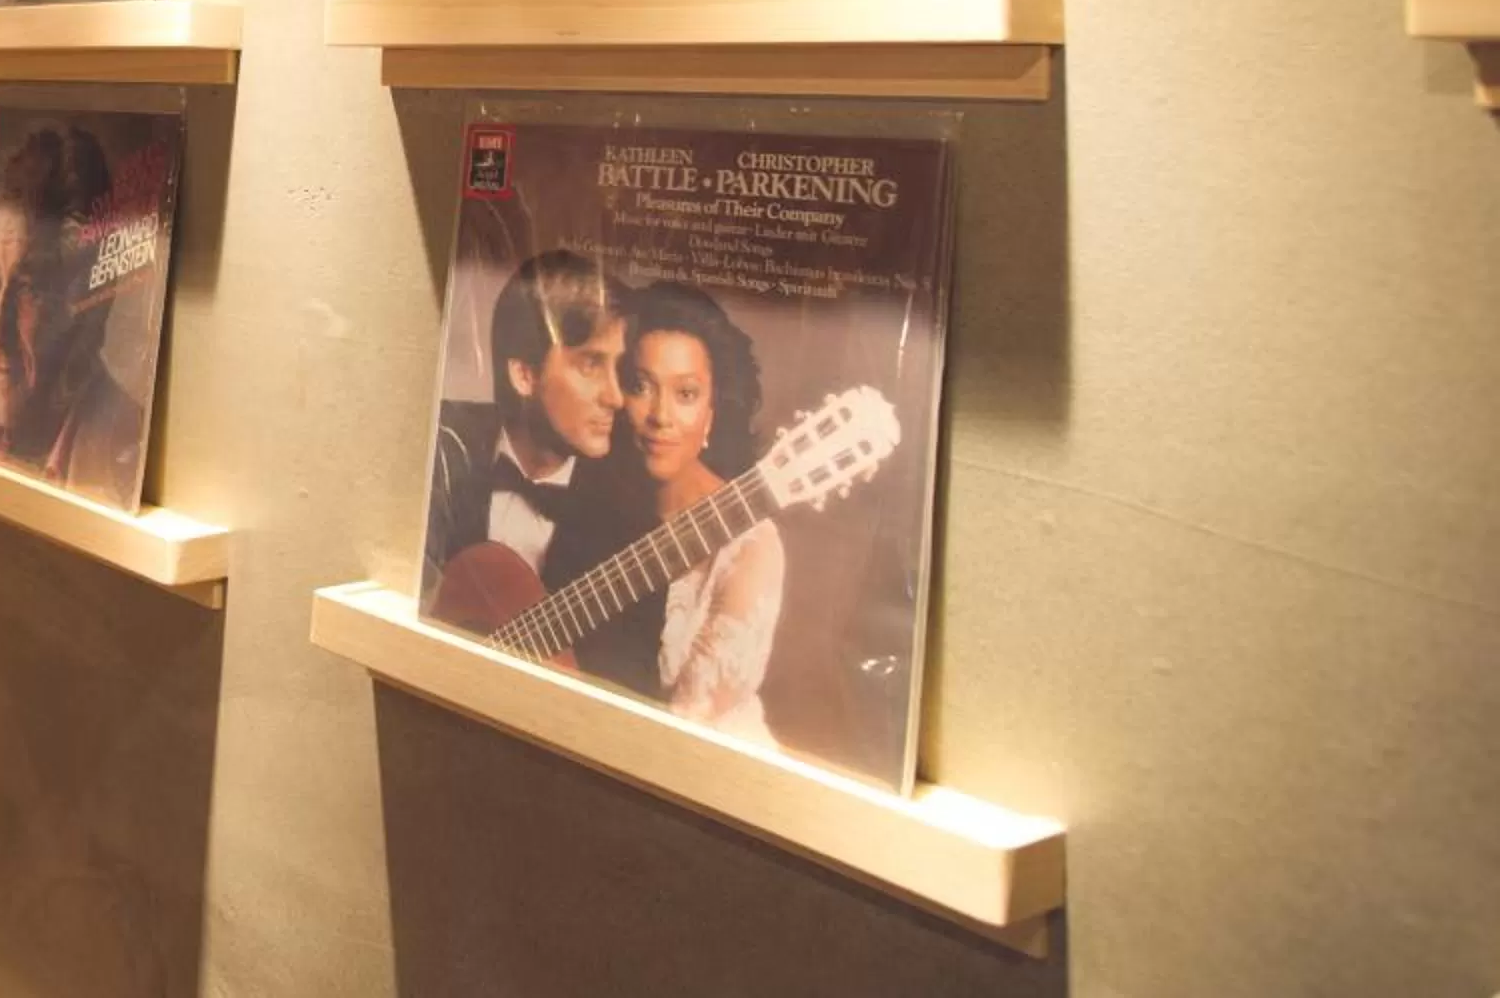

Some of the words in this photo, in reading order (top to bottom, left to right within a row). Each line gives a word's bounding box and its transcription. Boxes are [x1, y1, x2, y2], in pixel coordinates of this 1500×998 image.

[604, 145, 693, 165] KATHLEEN
[736, 151, 876, 177] CHRISTOPHER
[597, 161, 699, 192] BATTLE
[715, 168, 899, 208] PARKENING
[703, 199, 720, 215] of
[721, 198, 766, 219] Their
[766, 202, 845, 230] Company
[88, 238, 157, 291] BERNSTEIN
